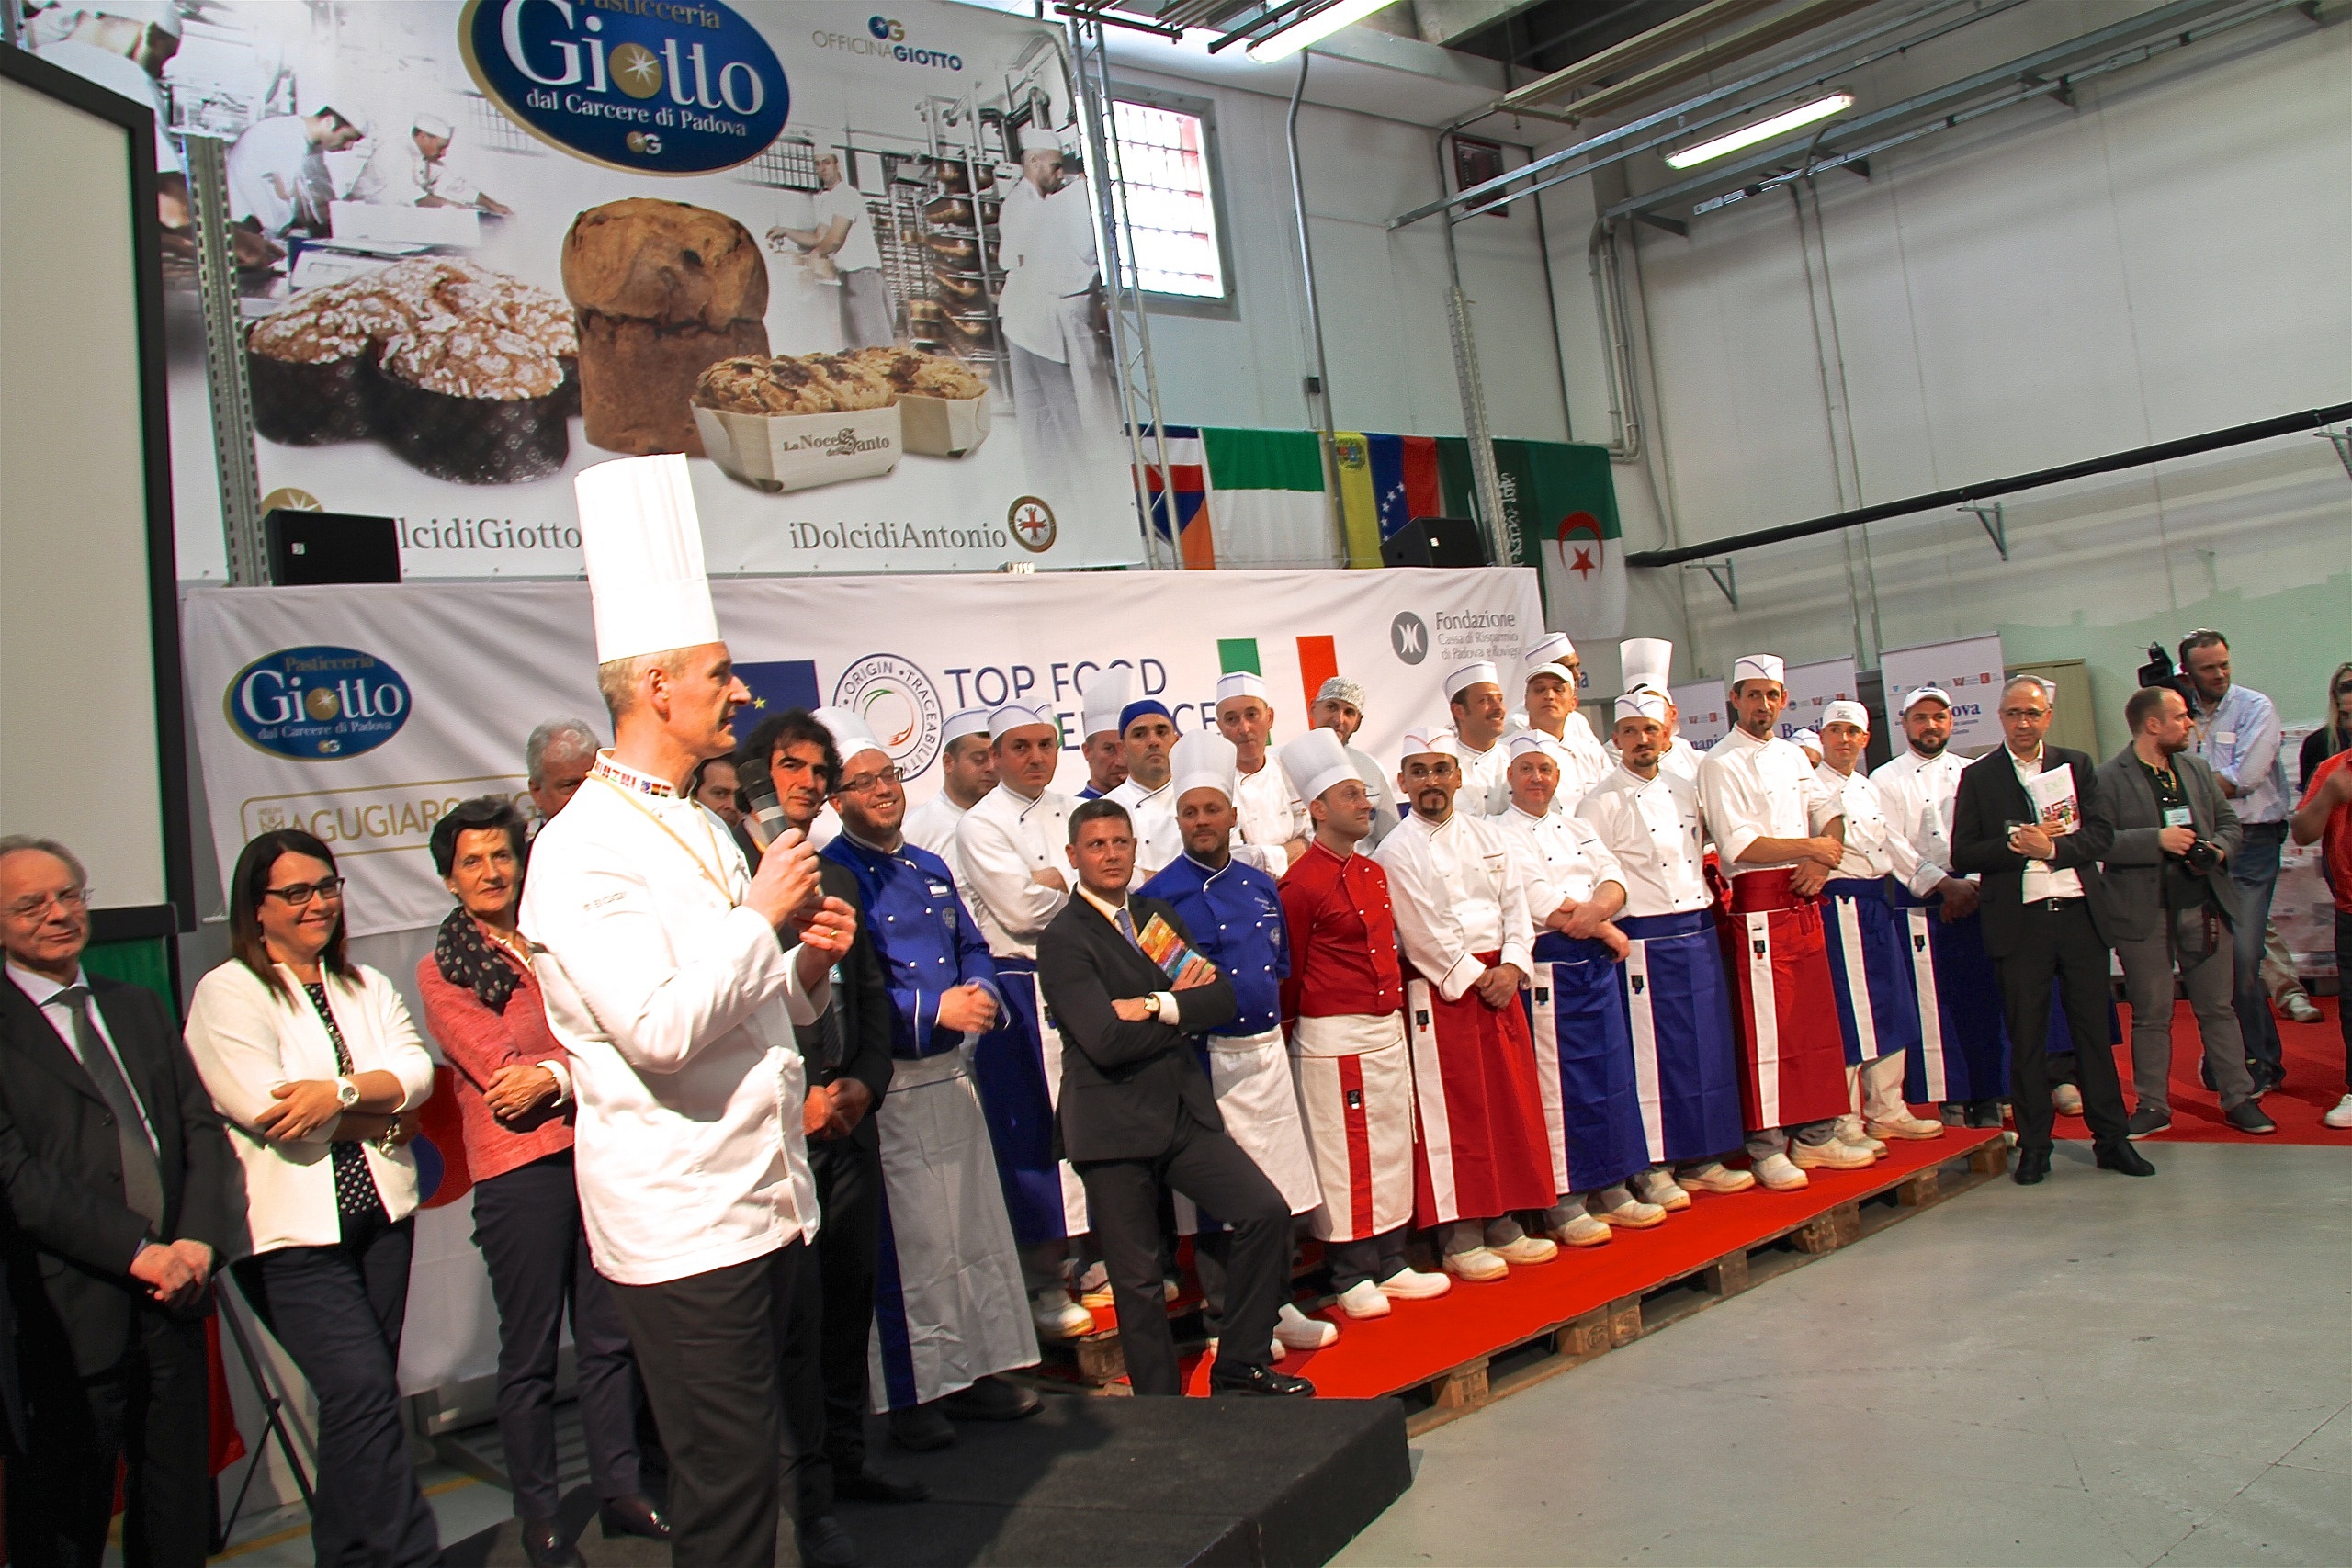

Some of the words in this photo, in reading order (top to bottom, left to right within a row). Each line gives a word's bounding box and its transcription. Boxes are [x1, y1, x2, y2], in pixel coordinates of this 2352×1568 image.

[579, 0, 720, 29] asticceria
[500, 0, 764, 116] Giotto
[526, 88, 559, 110] dal
[565, 93, 650, 123] Carcere
[655, 107, 674, 128] di
[681, 110, 747, 137] Padova
[398, 517, 582, 549] lcidiGiotto
[789, 522, 1007, 549] iDolcidiAntonio
[1436, 608, 1515, 631] Fondazione
[285, 654, 375, 672] Pasticceria
[844, 661, 893, 694] ORIGIN
[241, 670, 403, 725] Giotto
[944, 664, 1035, 708] TOP
[1050, 658, 1167, 702] FOD
